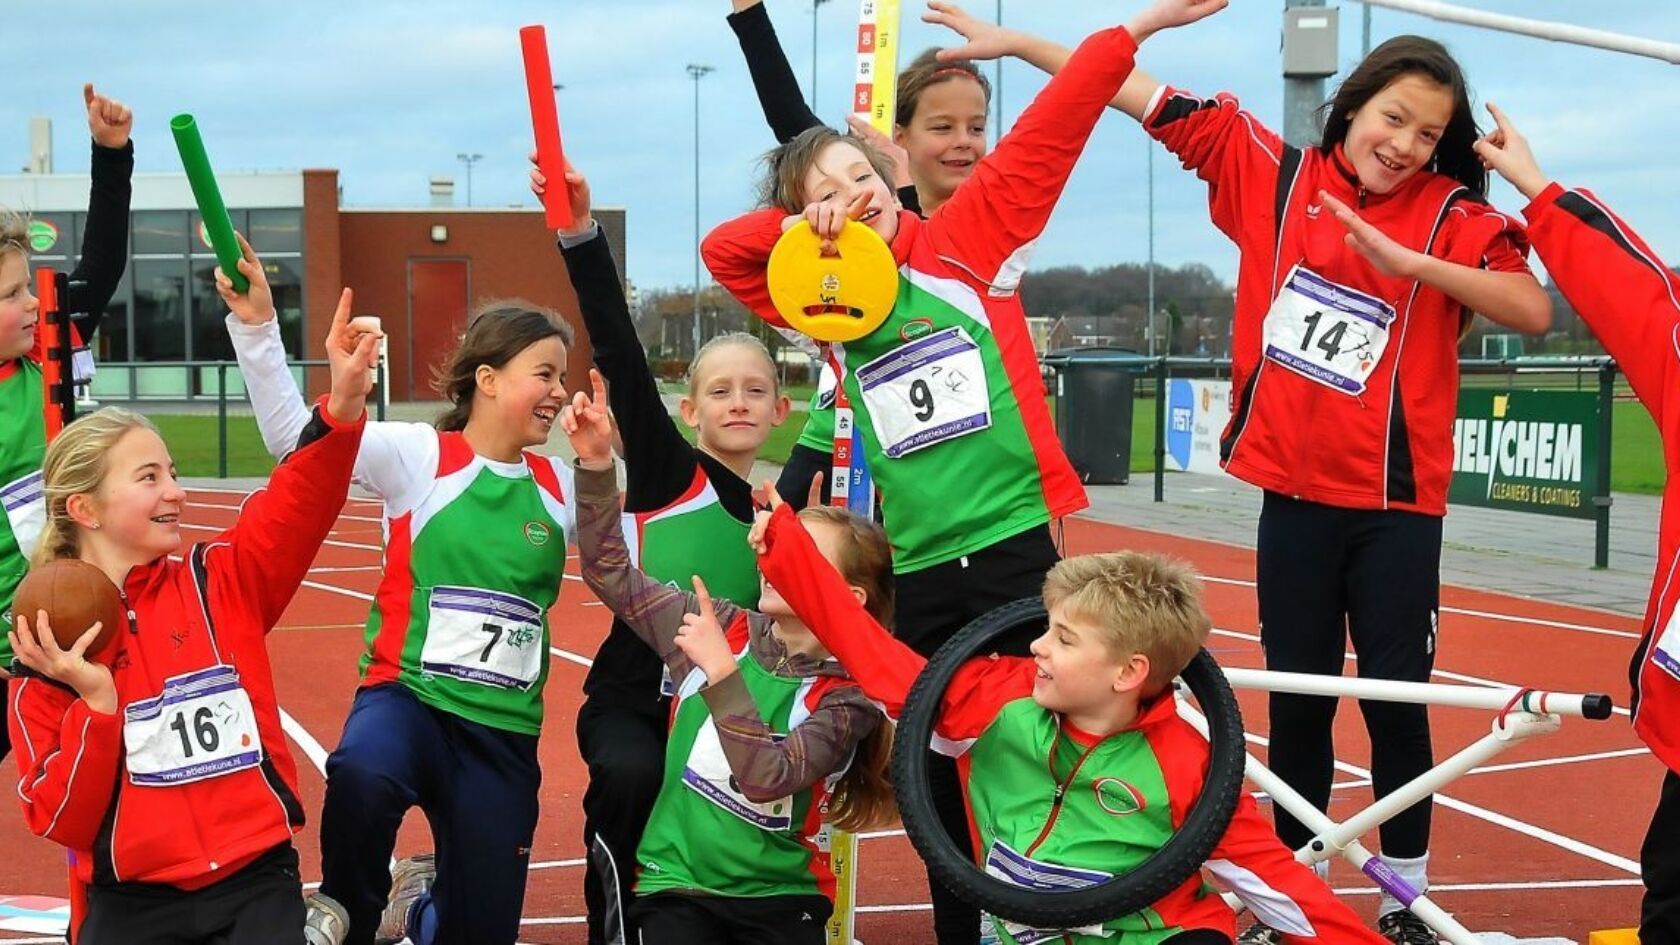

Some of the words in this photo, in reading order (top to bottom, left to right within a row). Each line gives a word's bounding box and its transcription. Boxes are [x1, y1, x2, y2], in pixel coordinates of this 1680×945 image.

[862, 31, 872, 45] 80
[879, 32, 889, 48] 1m
[859, 91, 869, 105] 90
[875, 103, 885, 119] 1m
[1300, 311, 1348, 361] 14
[1275, 351, 1345, 386] www.atletiekunie.nl
[909, 379, 934, 422] 9
[839, 416, 849, 429] 45
[899, 419, 972, 450] www.atletiekunie.nl
[837, 445, 848, 459] 50
[835, 475, 846, 488] 55
[853, 468, 864, 486] 2m
[1492, 482, 1530, 502] CLEANERS
[1540, 486, 1581, 507] COATINGS
[479, 622, 503, 662] 7
[170, 707, 220, 758] 16
[161, 757, 242, 781] www.atletiekunie.nl
[696, 778, 768, 825] www.atletiekunie.nl
[818, 832, 828, 843] 15
[834, 857, 844, 875] 3m
[831, 921, 842, 938] 3m
